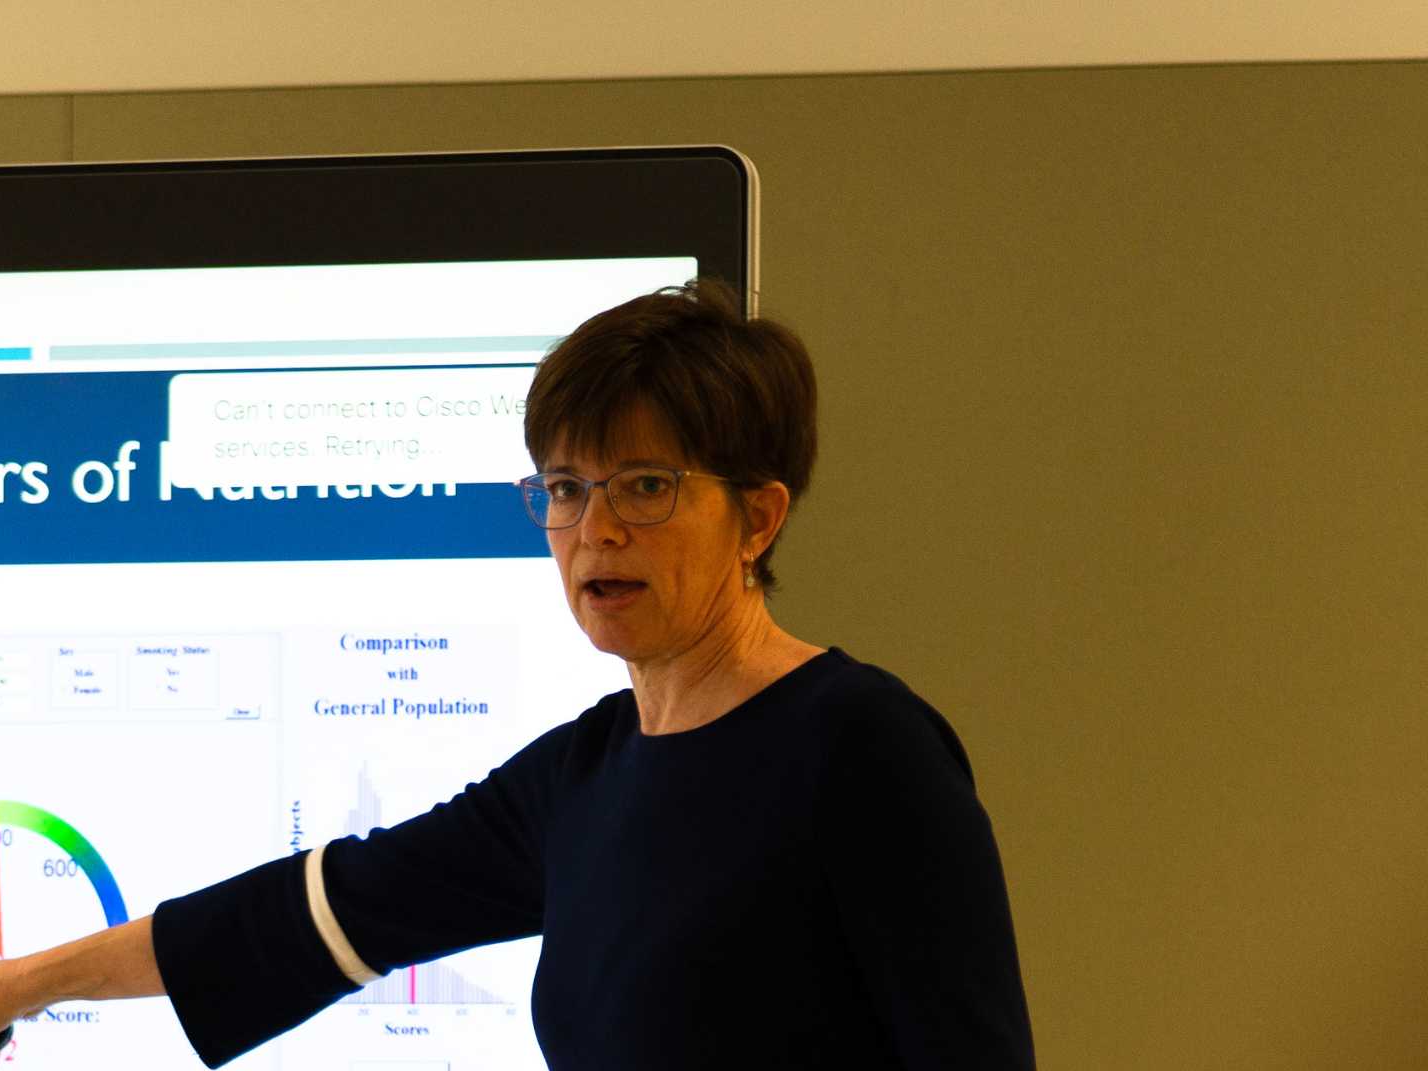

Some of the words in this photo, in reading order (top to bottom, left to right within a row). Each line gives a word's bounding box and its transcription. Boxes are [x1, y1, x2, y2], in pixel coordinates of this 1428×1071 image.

[213, 399, 274, 421] Can't
[283, 401, 377, 419] connect
[385, 401, 407, 418] to
[416, 395, 482, 417] Cisco
[490, 394, 527, 416] We
[72, 440, 140, 503] of
[339, 632, 450, 655] Comparison
[387, 667, 419, 681] with
[314, 698, 386, 716] General
[392, 697, 489, 719] Population
[43, 858, 77, 878] 600
[384, 1023, 430, 1036] Scores
